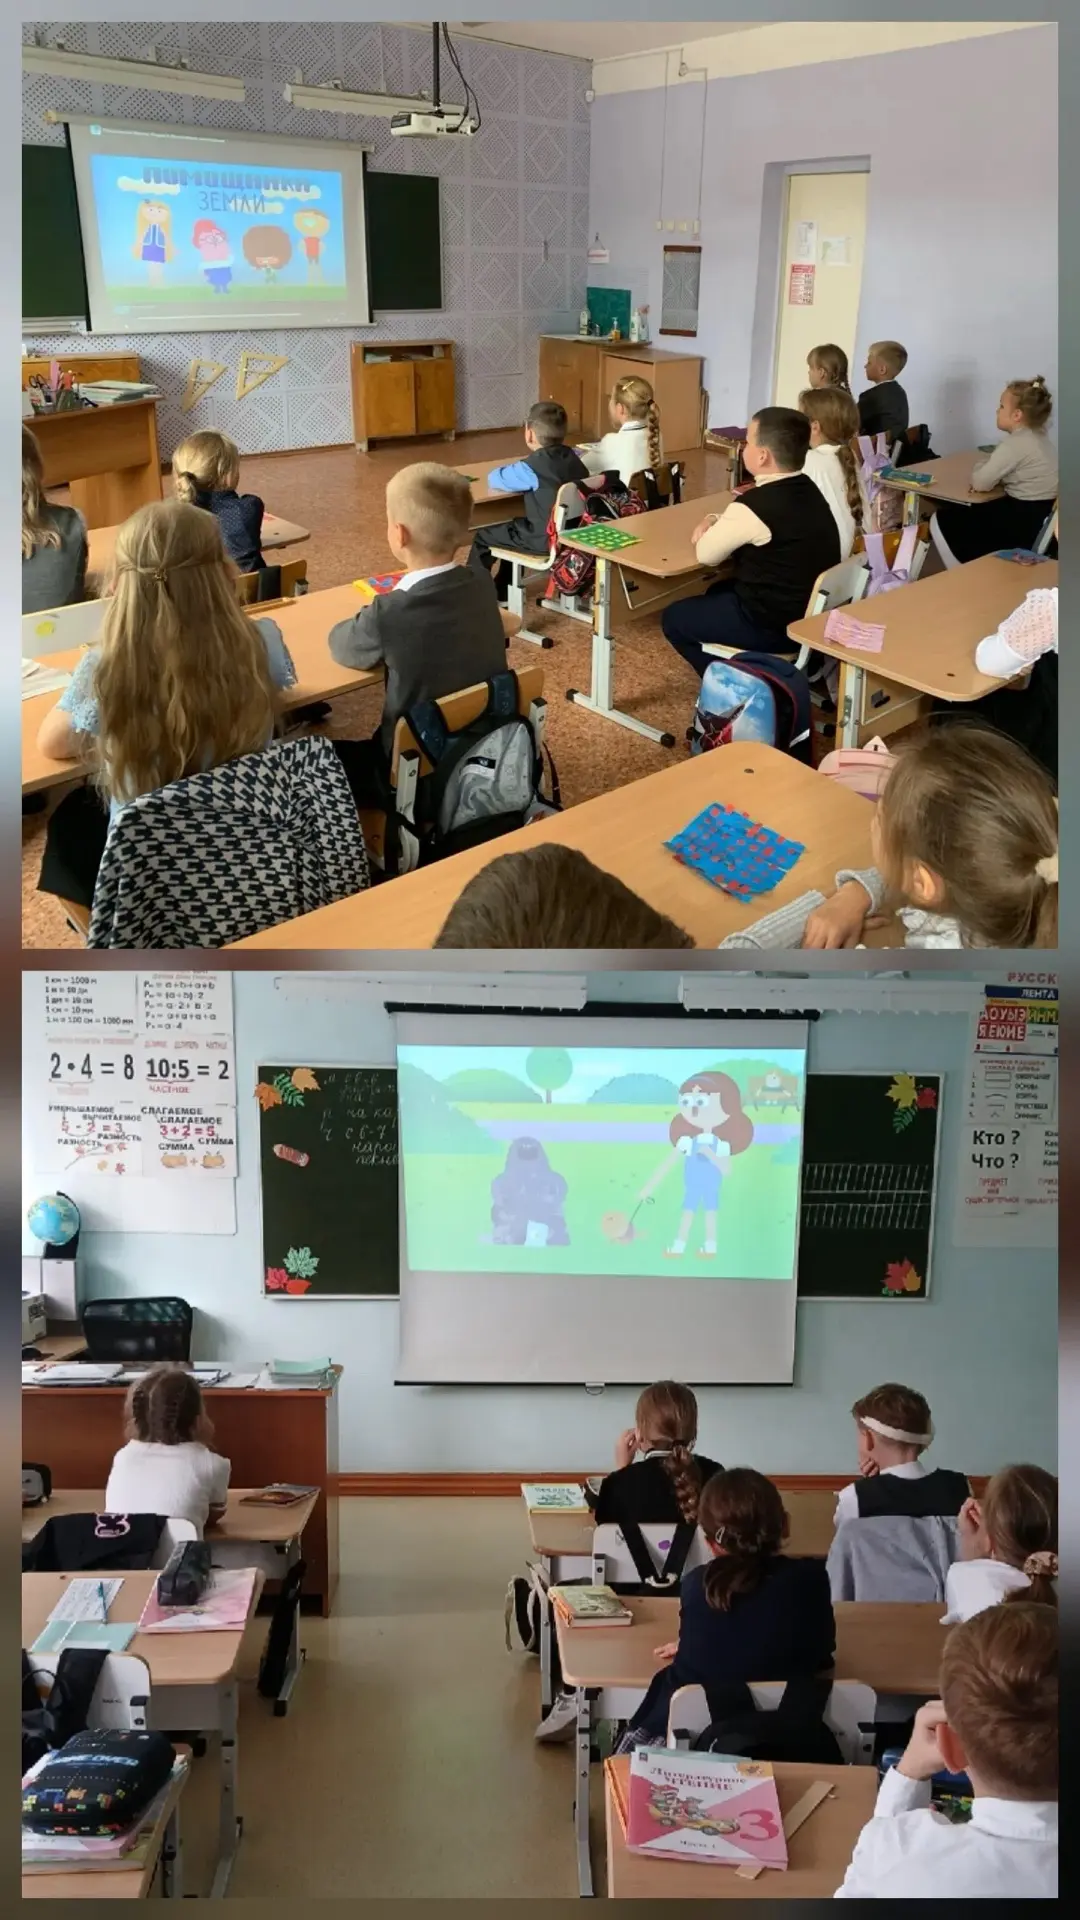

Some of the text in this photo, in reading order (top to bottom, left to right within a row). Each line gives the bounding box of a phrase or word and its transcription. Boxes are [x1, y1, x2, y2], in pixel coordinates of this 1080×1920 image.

[198, 191, 265, 213] ЗЕМЛИ
[1021, 988, 1056, 999] ЛЕНТА
[50, 1052, 61, 1079] 2
[80, 1053, 93, 1080] 4
[123, 1053, 135, 1080] 8
[218, 1059, 230, 1080] 2
[48, 1105, 115, 1113] УМЕНЬШАЕМОЕ
[141, 1106, 203, 1115] СЛАГАЕМОЕ
[82, 1113, 142, 1121] ВЫЧИТАЕМОЕ
[160, 1116, 223, 1124] СЛАГАЕМОЕ
[160, 1125, 168, 1136] 3
[182, 1125, 190, 1136] 2
[207, 1126, 215, 1136] 5
[97, 1133, 142, 1141] РАЗНОСТЬ
[198, 1137, 234, 1145] СУММА
[973, 1130, 1005, 1145] Кто
[57, 1138, 103, 1147] РАЗНОСТЬ
[158, 1142, 195, 1150] СУММА
[971, 1153, 1005, 1169] Что
[739, 1809, 779, 1841] 3
